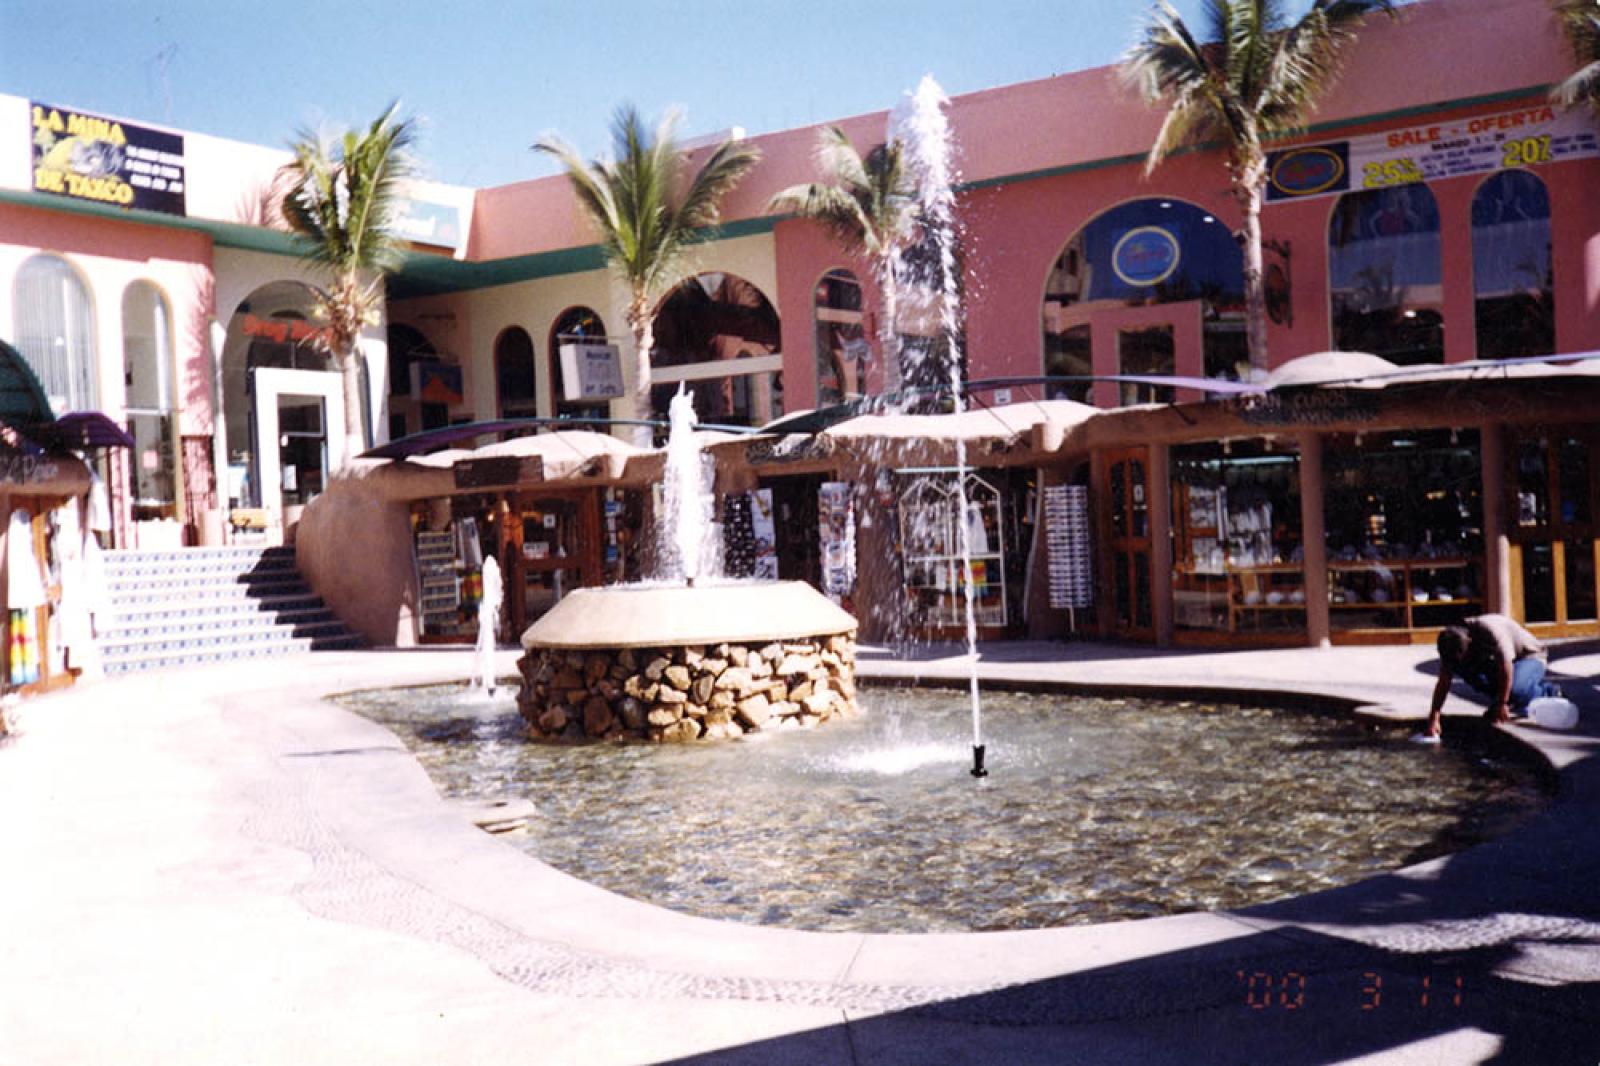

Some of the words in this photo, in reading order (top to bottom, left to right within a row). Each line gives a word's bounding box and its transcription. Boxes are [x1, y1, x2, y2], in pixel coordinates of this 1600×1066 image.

[32, 106, 64, 132] LA
[68, 113, 126, 145] MINA
[1387, 127, 1441, 148] SALE
[1467, 107, 1554, 134] OFERTA
[35, 168, 64, 192] DE
[65, 173, 134, 204] TAXCO
